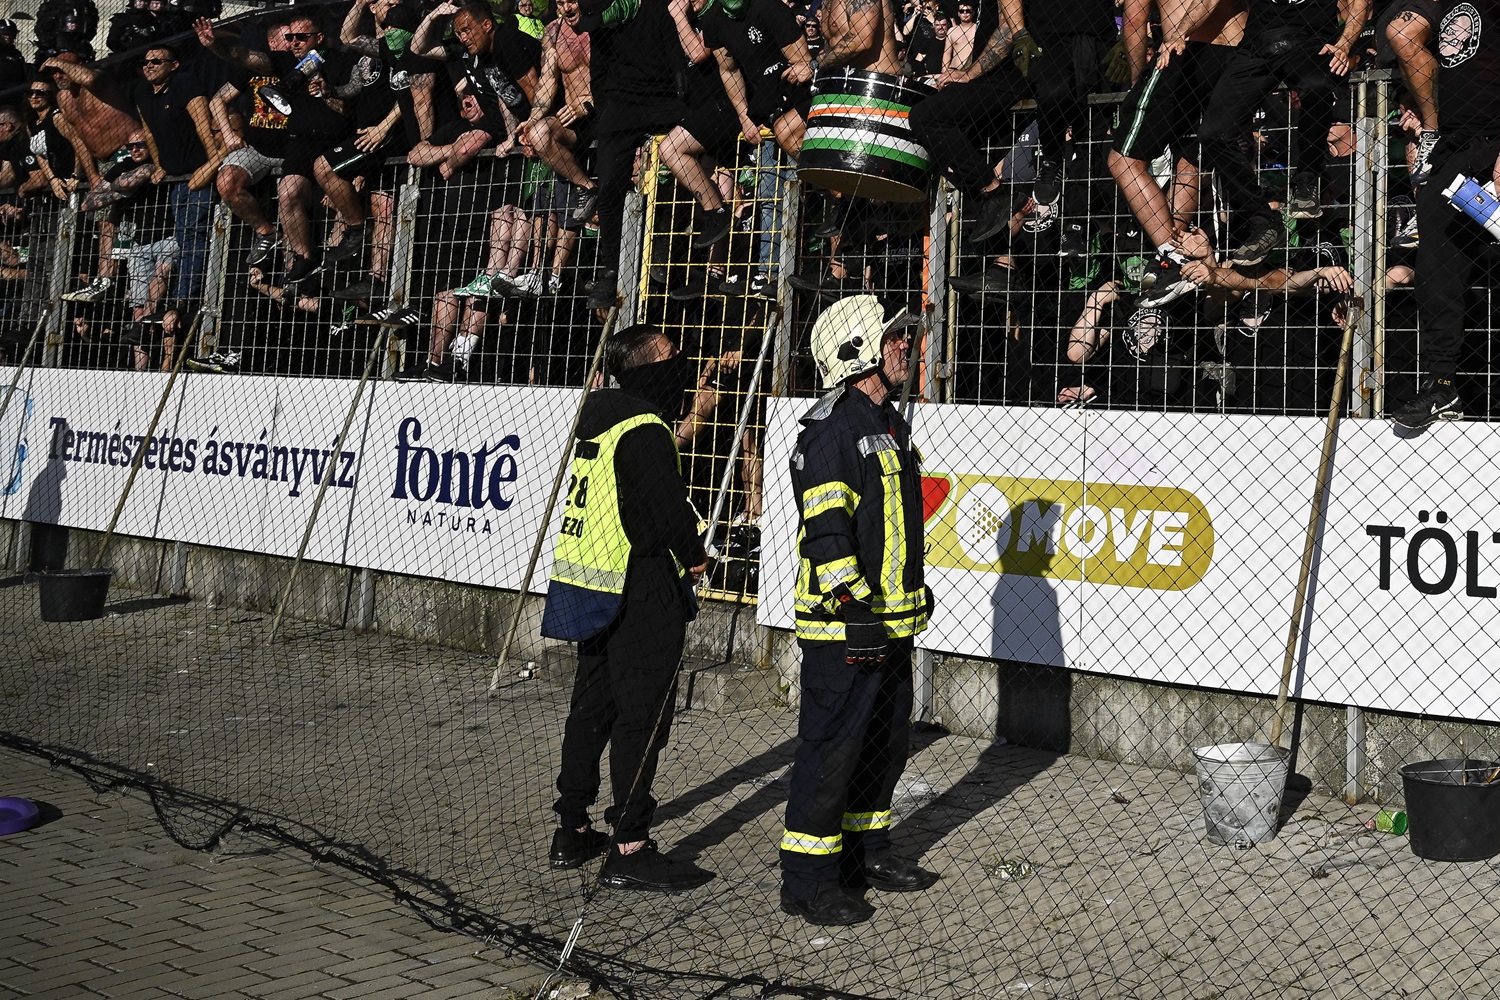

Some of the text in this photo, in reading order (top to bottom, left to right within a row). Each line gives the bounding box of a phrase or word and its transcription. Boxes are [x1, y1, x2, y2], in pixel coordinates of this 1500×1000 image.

[48, 416, 357, 498] Természetes ásványvíz
[406, 509, 492, 535] NATURA
[1016, 500, 1189, 568] MOVE
